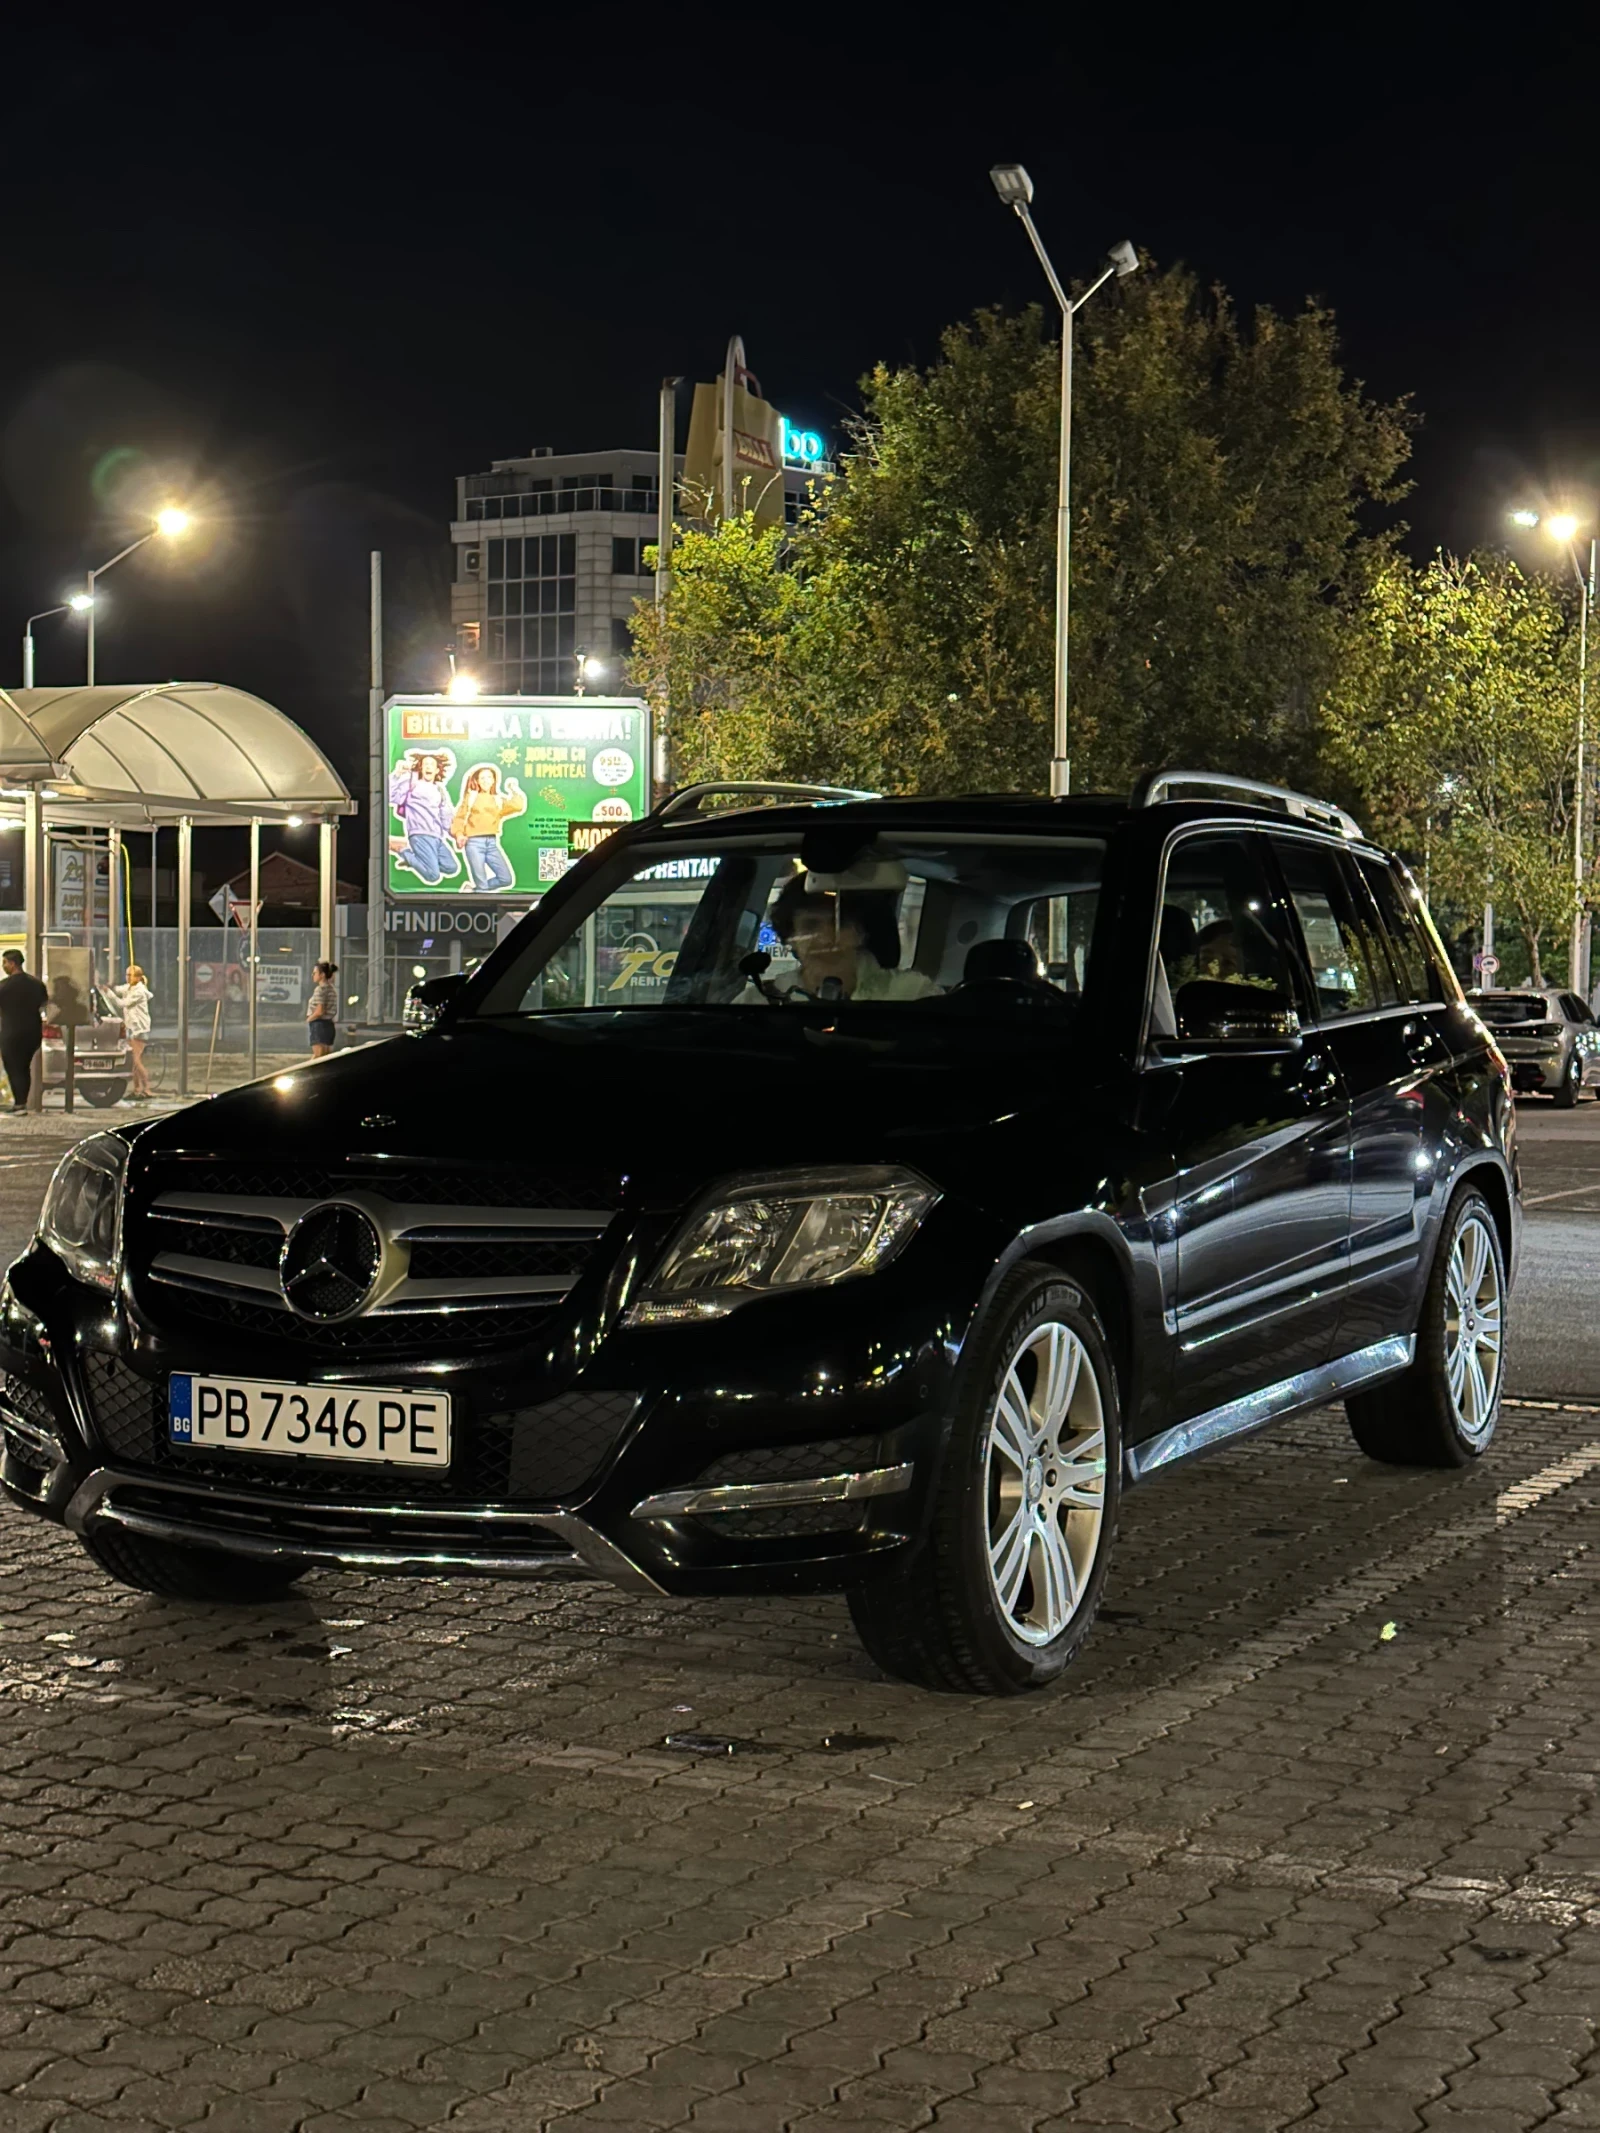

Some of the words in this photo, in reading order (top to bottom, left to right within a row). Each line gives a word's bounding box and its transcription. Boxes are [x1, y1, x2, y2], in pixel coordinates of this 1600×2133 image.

[406, 714, 465, 735] BILLA
[601, 805, 623, 816] 500
[173, 1416, 190, 1433] BG
[198, 1386, 250, 1438] PB
[260, 1391, 367, 1448] 7346
[378, 1401, 438, 1455] PE
